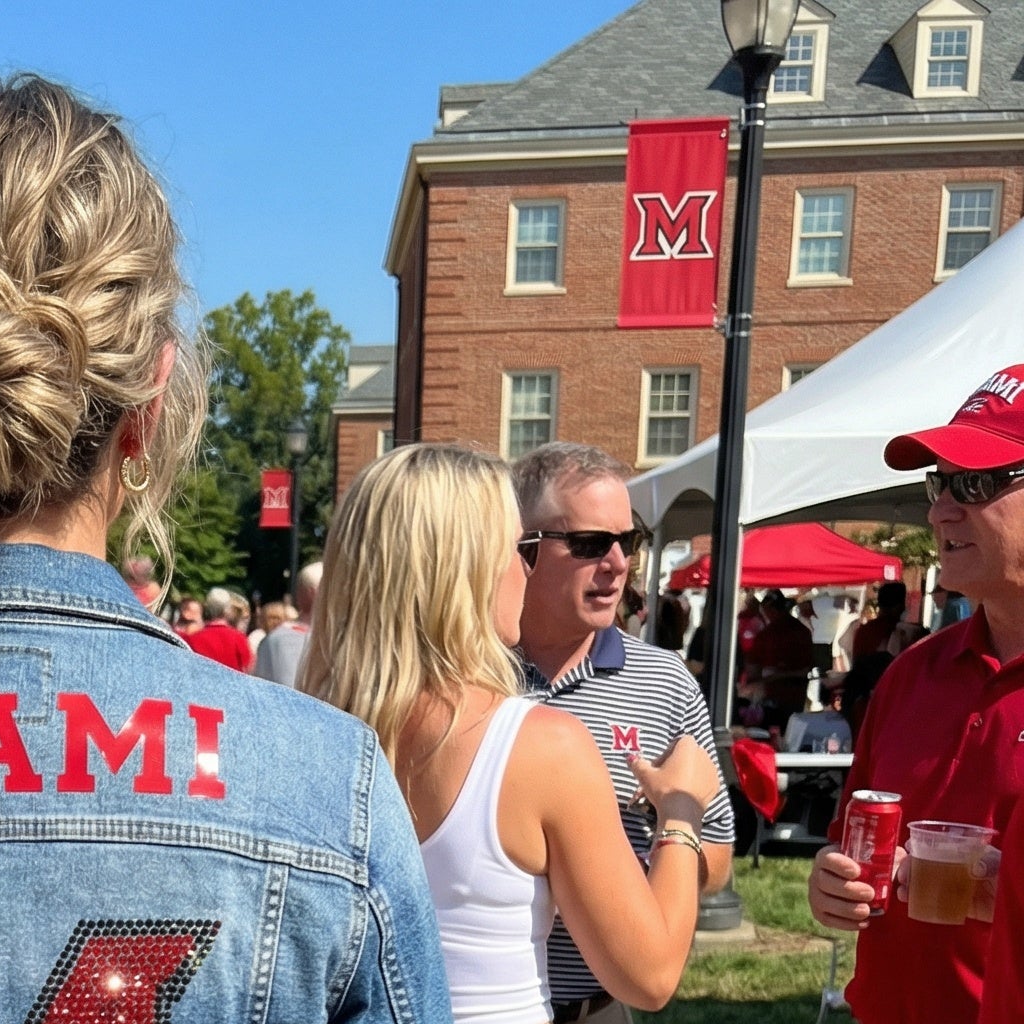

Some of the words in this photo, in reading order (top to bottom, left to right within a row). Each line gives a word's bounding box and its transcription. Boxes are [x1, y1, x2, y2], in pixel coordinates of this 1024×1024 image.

[628, 189, 718, 262] M
[262, 486, 290, 509] M
[610, 723, 641, 752] M
